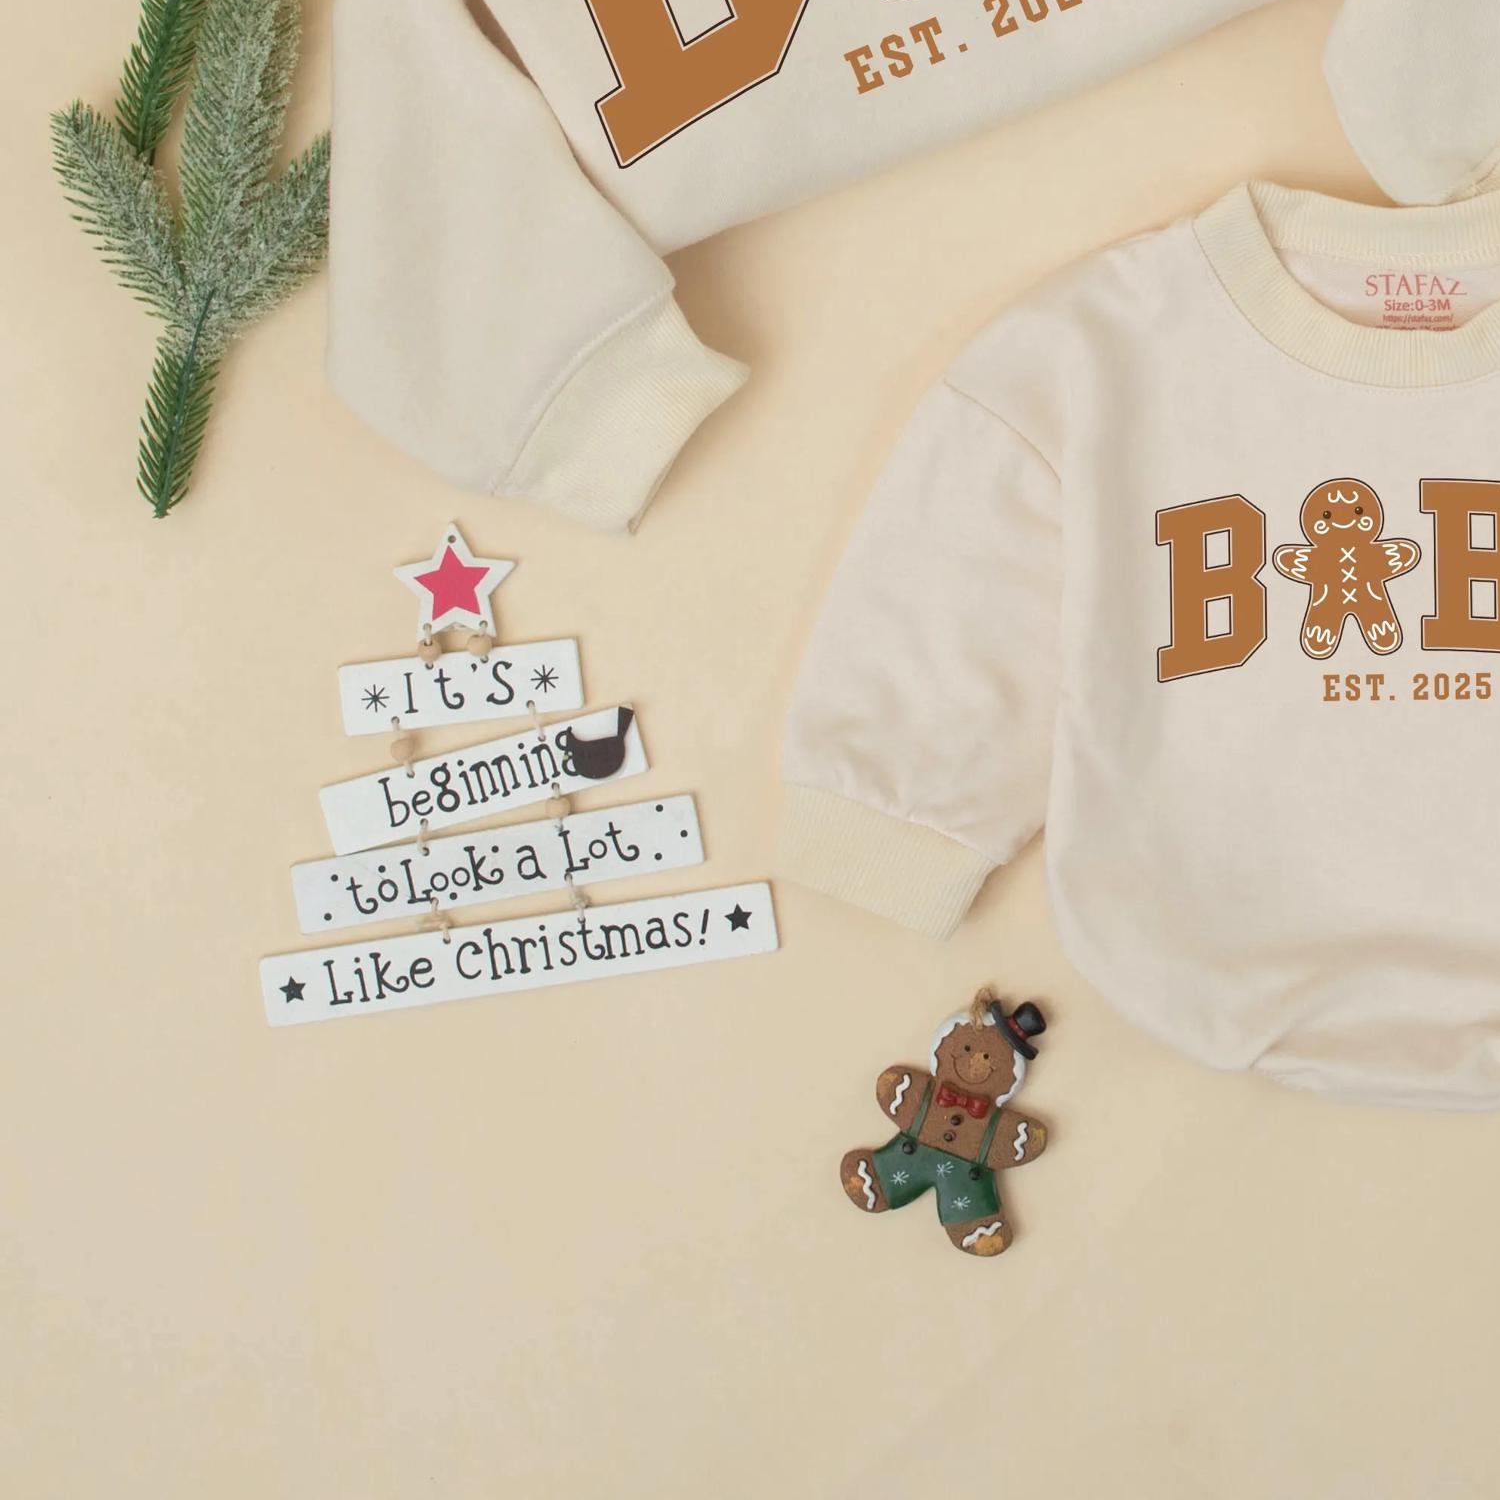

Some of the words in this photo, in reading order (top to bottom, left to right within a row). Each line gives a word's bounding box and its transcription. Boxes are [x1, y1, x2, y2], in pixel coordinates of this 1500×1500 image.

[844, 16, 968, 95] EST.
[1365, 273, 1467, 296] STAFAZ
[1323, 674, 1396, 702] EST.
[1413, 672, 1493, 700] 2025
[346, 875, 399, 915] to
[517, 844, 547, 882] a
[323, 952, 436, 1007] Like
